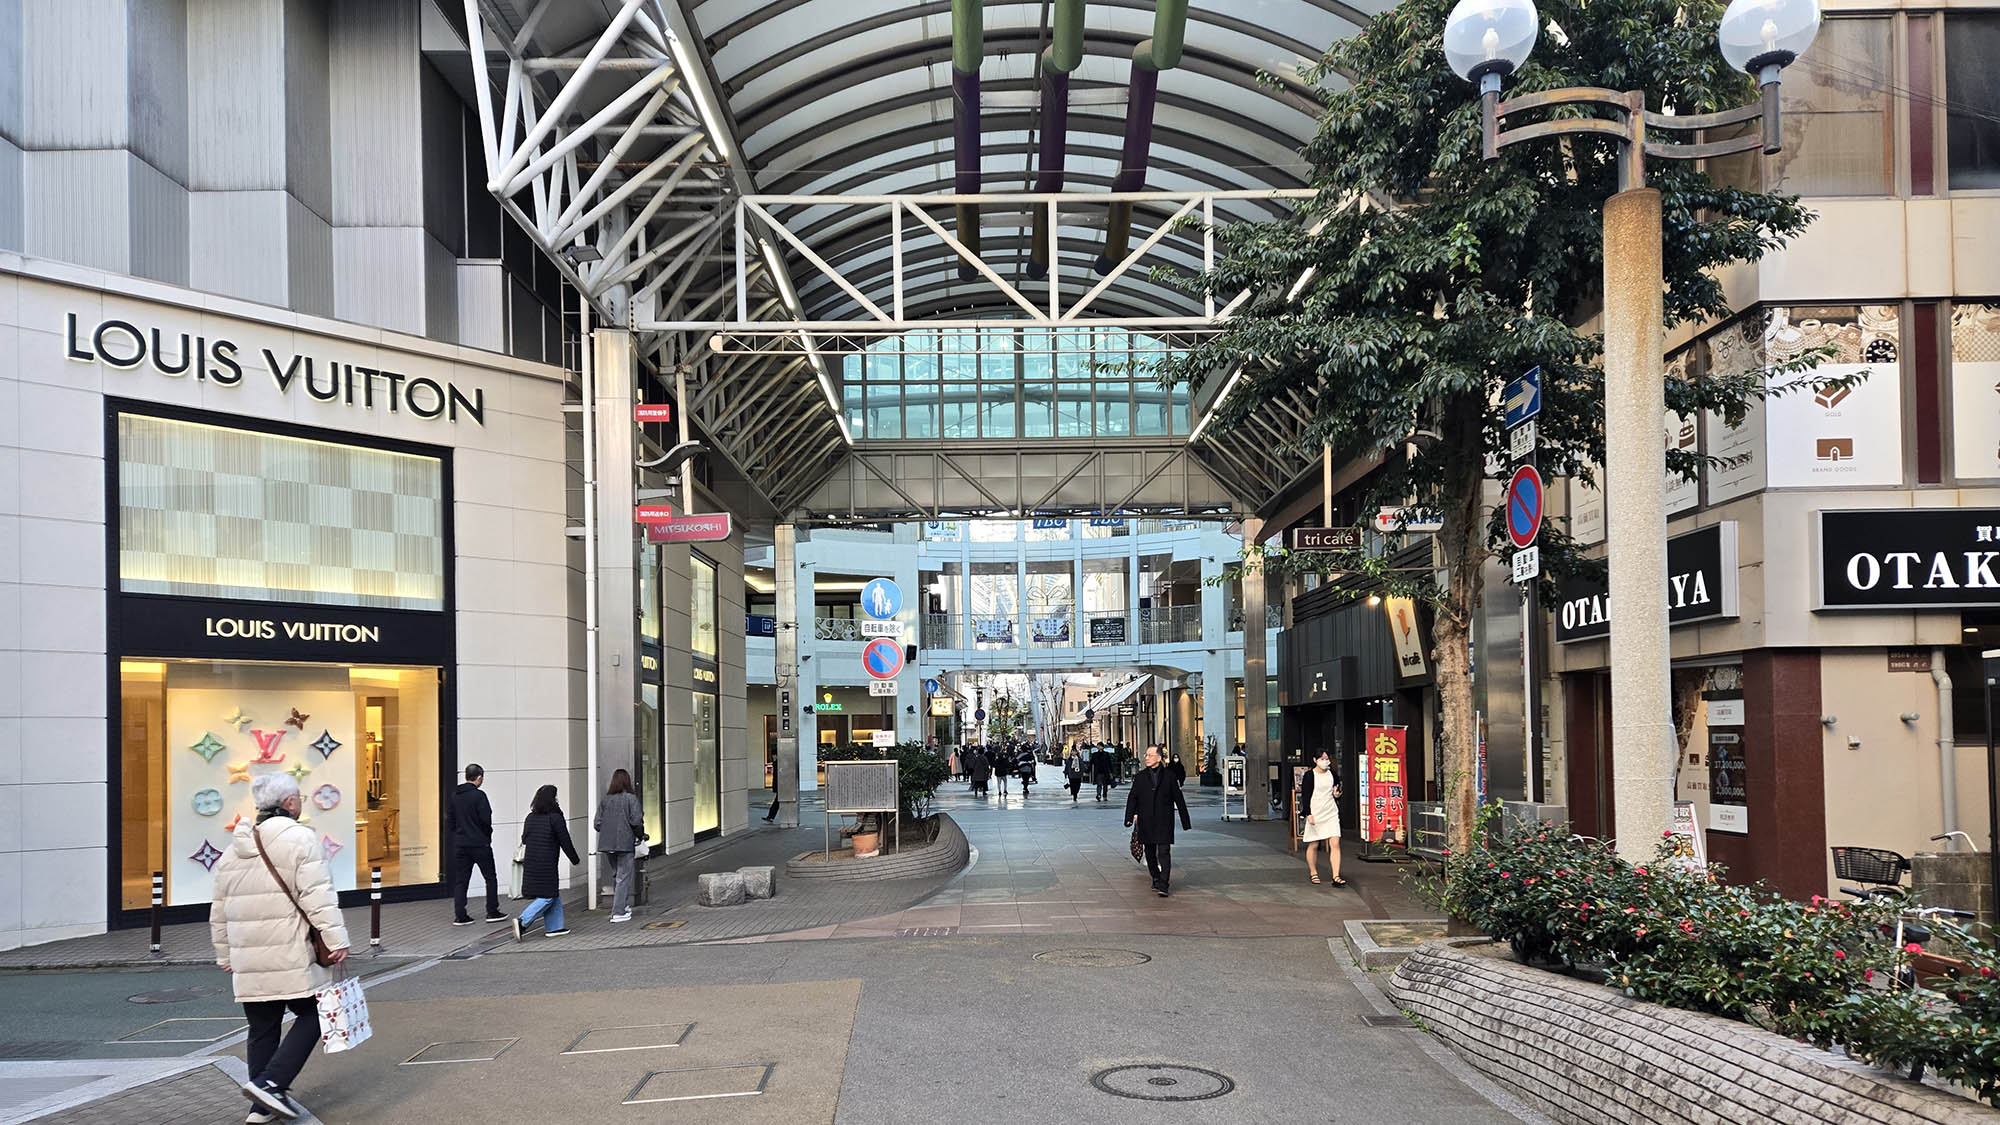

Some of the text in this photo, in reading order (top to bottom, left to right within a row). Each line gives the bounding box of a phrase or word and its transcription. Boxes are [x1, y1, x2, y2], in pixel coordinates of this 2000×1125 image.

[67, 312, 486, 427] LOUIS VUITTON
[654, 523, 722, 534] MITSUKOSHI
[1304, 533, 1354, 545] tri café
[205, 617, 380, 643] LOUIS VUITTON
[864, 623, 901, 634] 自転車を除く
[815, 703, 842, 711] ROLEX
[1375, 732, 1400, 783] お酒
[1375, 797, 1387, 824] ます
[1390, 785, 1404, 811] 買い
